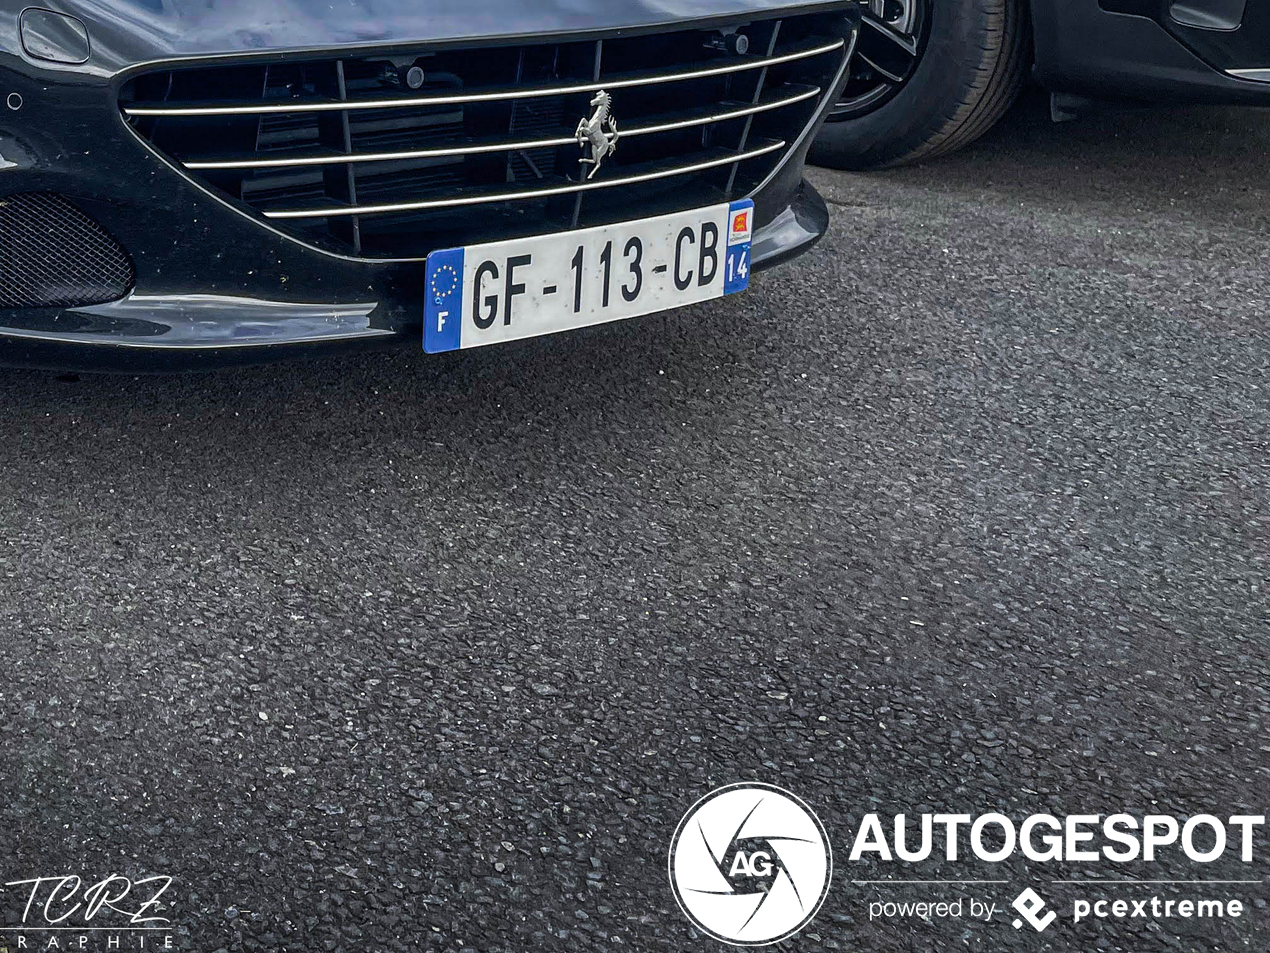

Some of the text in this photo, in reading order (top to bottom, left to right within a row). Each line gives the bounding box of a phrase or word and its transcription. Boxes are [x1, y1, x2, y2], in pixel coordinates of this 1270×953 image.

[472, 221, 719, 330] GF-113-CB
[727, 251, 748, 283] 14
[437, 311, 449, 333] F
